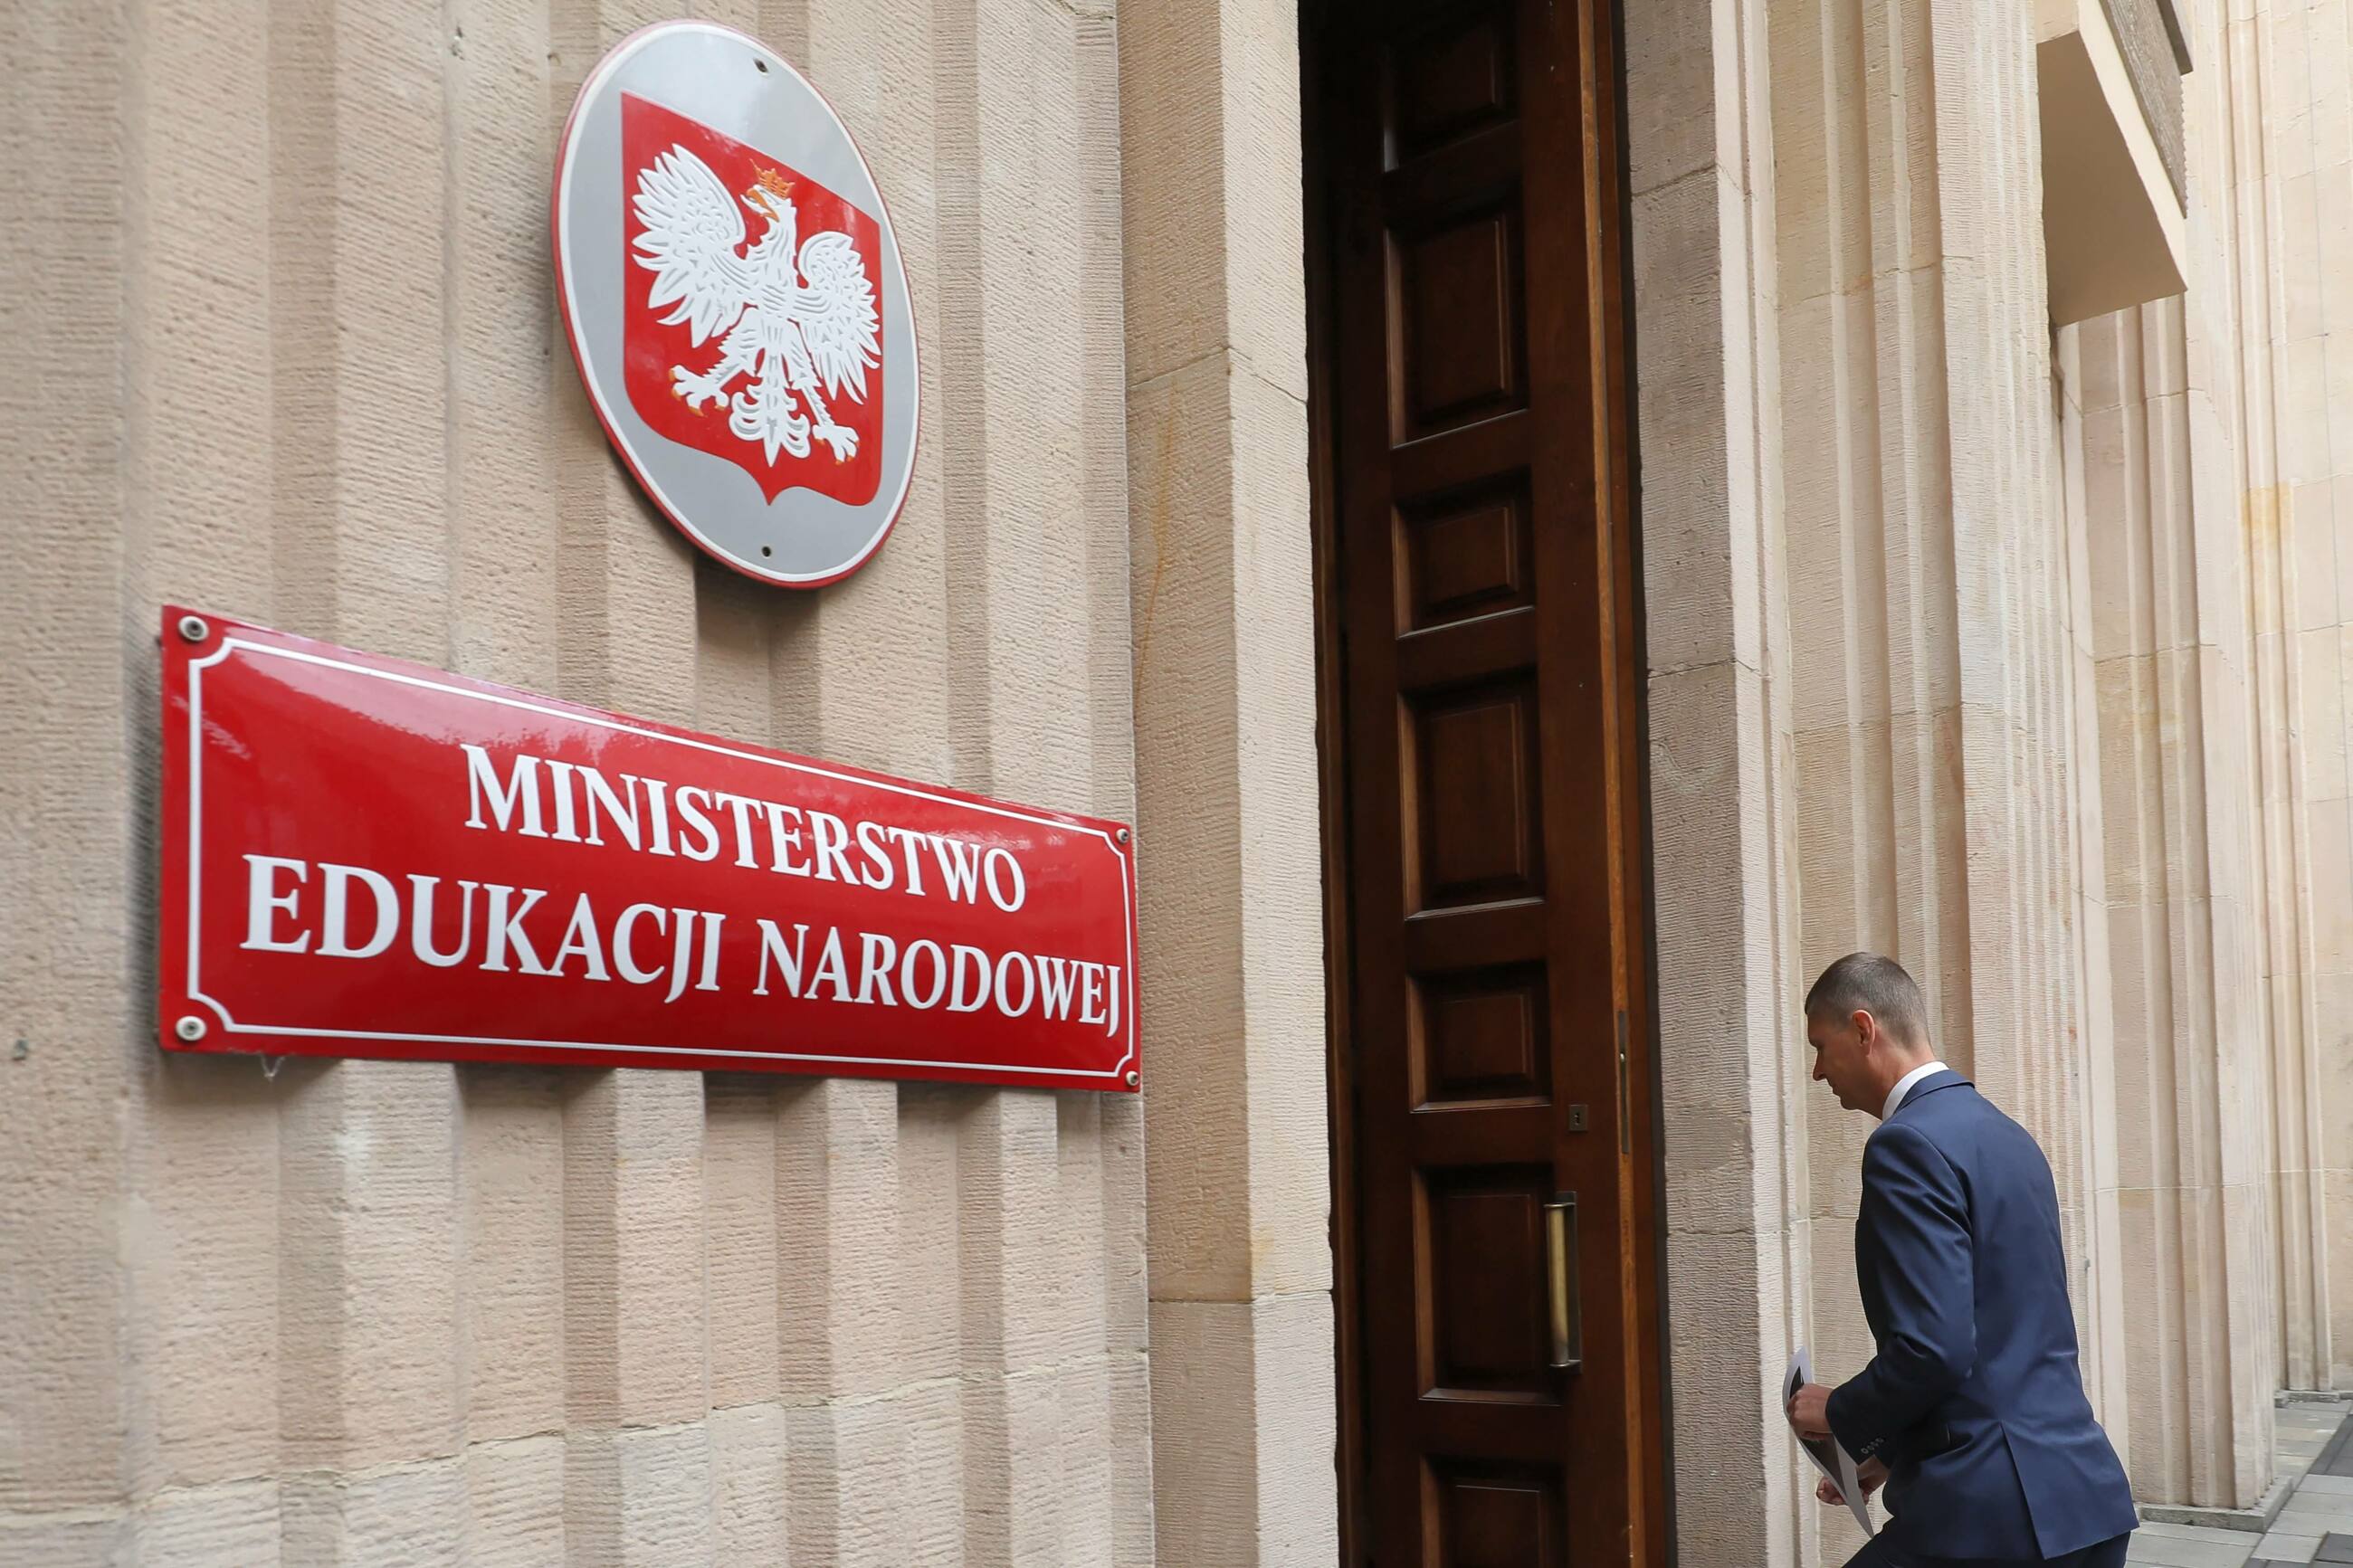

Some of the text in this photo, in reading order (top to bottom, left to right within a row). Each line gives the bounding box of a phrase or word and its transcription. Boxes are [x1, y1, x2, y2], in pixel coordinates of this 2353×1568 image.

[460, 744, 1025, 913] MINISTERSTWO
[241, 853, 1121, 1037] EDUKACJI NARODOWEJ
